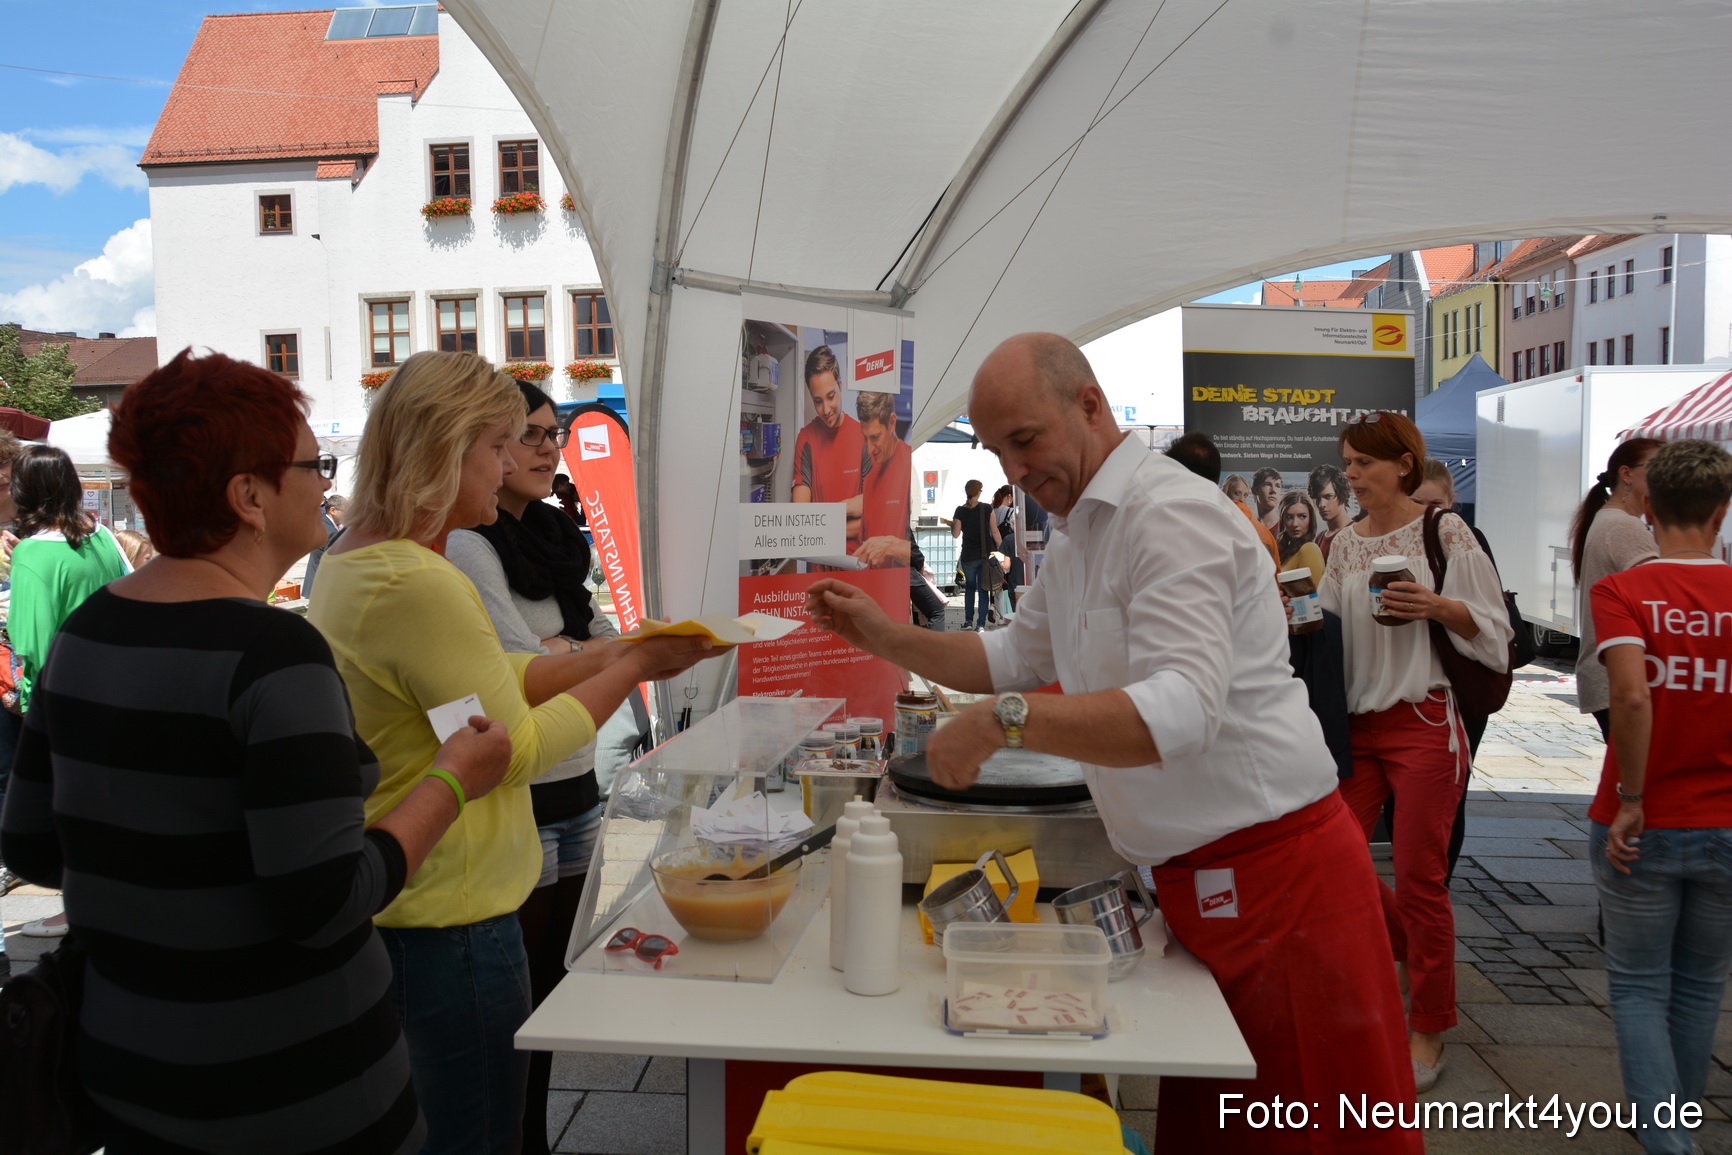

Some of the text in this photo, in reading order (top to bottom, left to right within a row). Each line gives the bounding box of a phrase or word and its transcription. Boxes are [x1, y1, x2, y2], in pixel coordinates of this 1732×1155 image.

[865, 358, 885, 372] DEHN
[1192, 384, 1336, 406] DEINE STADT
[1241, 405, 1351, 426] BRAUCHT
[754, 514, 826, 527] DEHN INSTATEC
[754, 534, 826, 548] Alles mit Strom.
[753, 590, 806, 604] Ausbildung
[783, 605, 812, 618] INSTA
[753, 641, 763, 649] und
[776, 637, 808, 647] Möglichkeiten
[808, 634, 833, 643] verspricht?
[753, 656, 769, 664] Werde
[771, 654, 779, 662] Teil
[792, 652, 808, 661] großen
[808, 650, 822, 658] Teams
[833, 647, 847, 655] erlebe
[762, 663, 803, 674] Tätigkeitsbereiche
[823, 657, 849, 665] bundesweit
[752, 670, 812, 684] Handwerksunternehmen!
[1644, 654, 1732, 693] DEH
[752, 689, 786, 698] Elektroniker
